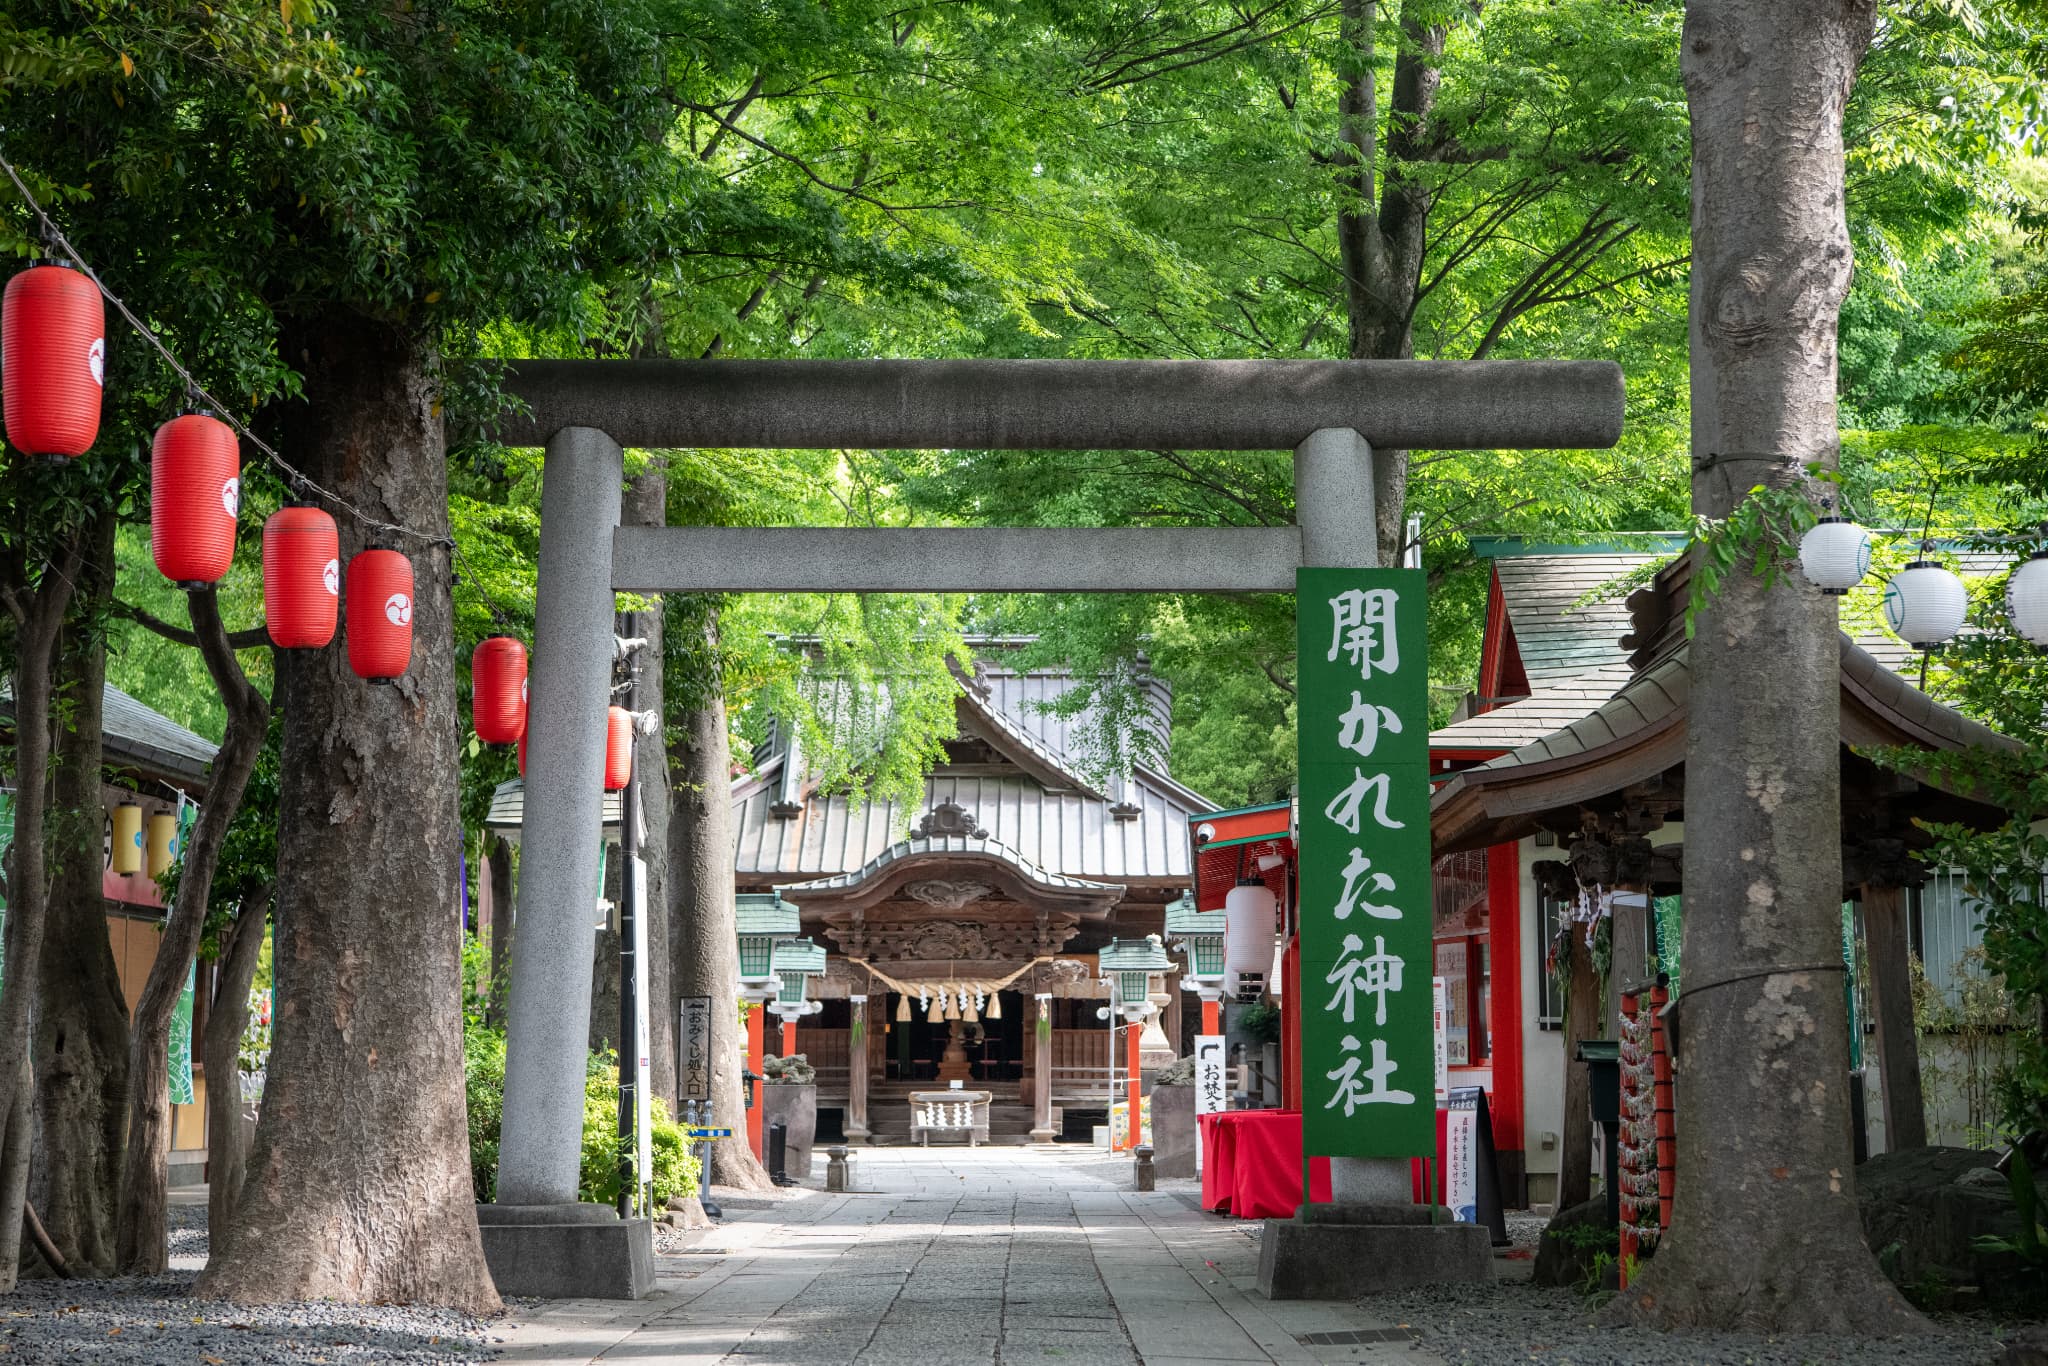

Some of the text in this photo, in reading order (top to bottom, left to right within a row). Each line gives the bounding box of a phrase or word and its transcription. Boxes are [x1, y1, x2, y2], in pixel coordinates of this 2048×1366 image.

[1325, 588, 1416, 1118] 開かれた神社
[687, 1011, 702, 1095] おみくじ処入口
